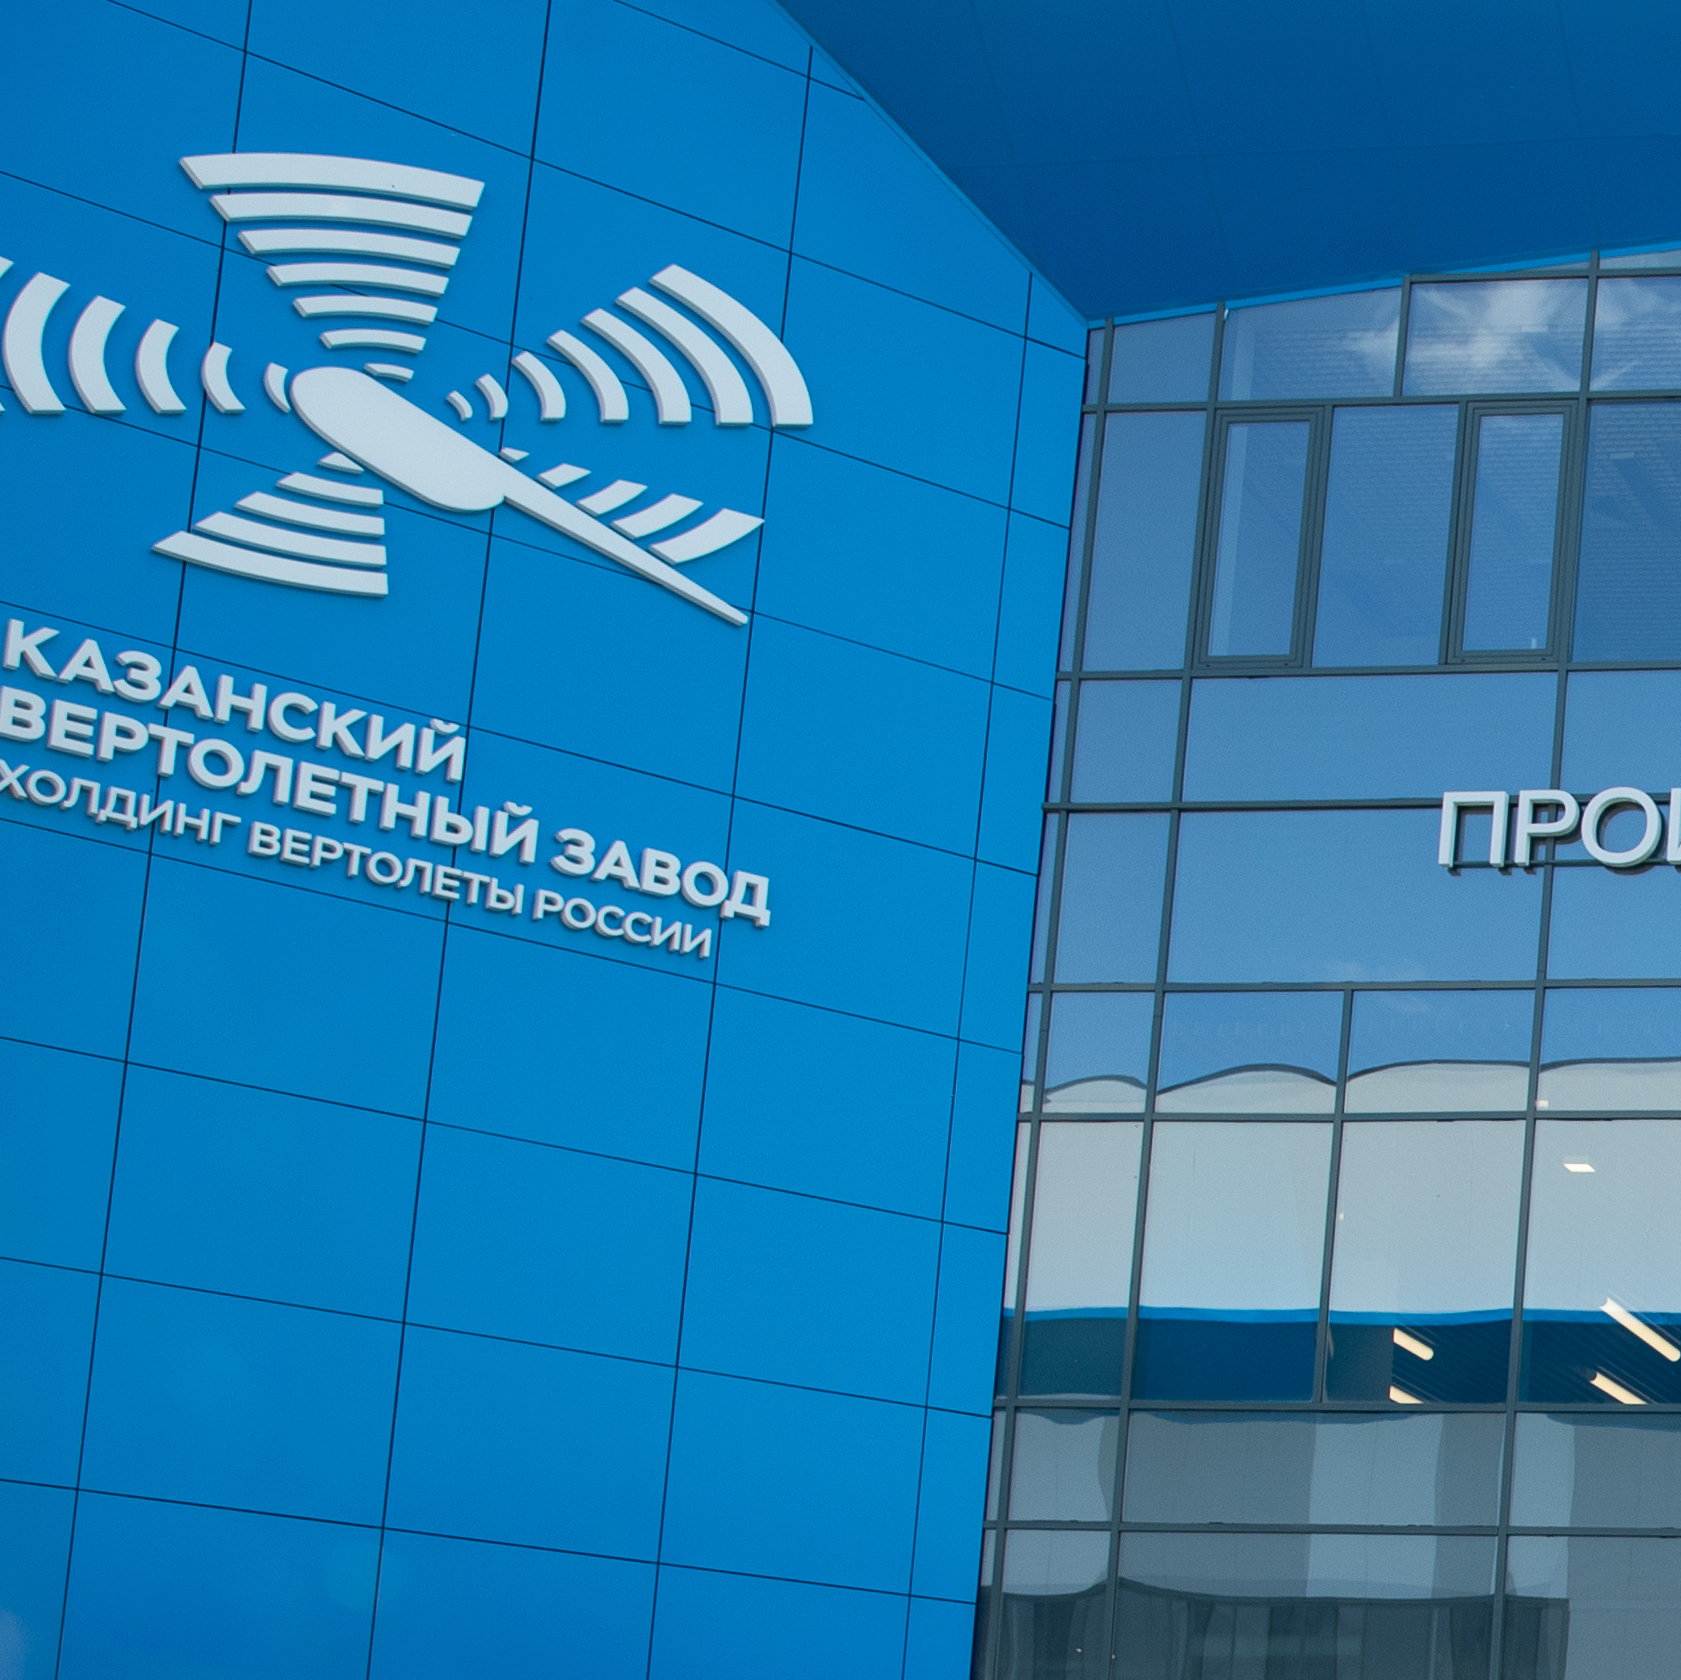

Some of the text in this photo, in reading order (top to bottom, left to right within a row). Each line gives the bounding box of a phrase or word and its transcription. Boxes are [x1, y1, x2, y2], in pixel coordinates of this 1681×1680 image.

[3, 618, 467, 783] КАЗАНСКИЙ
[0, 686, 771, 927] ВЕРТОЛЕТНЫЙ ЗАВОД
[0, 761, 712, 959] ХОЛДИНГ ВЕРТОЛЕТЫ РОССИИ
